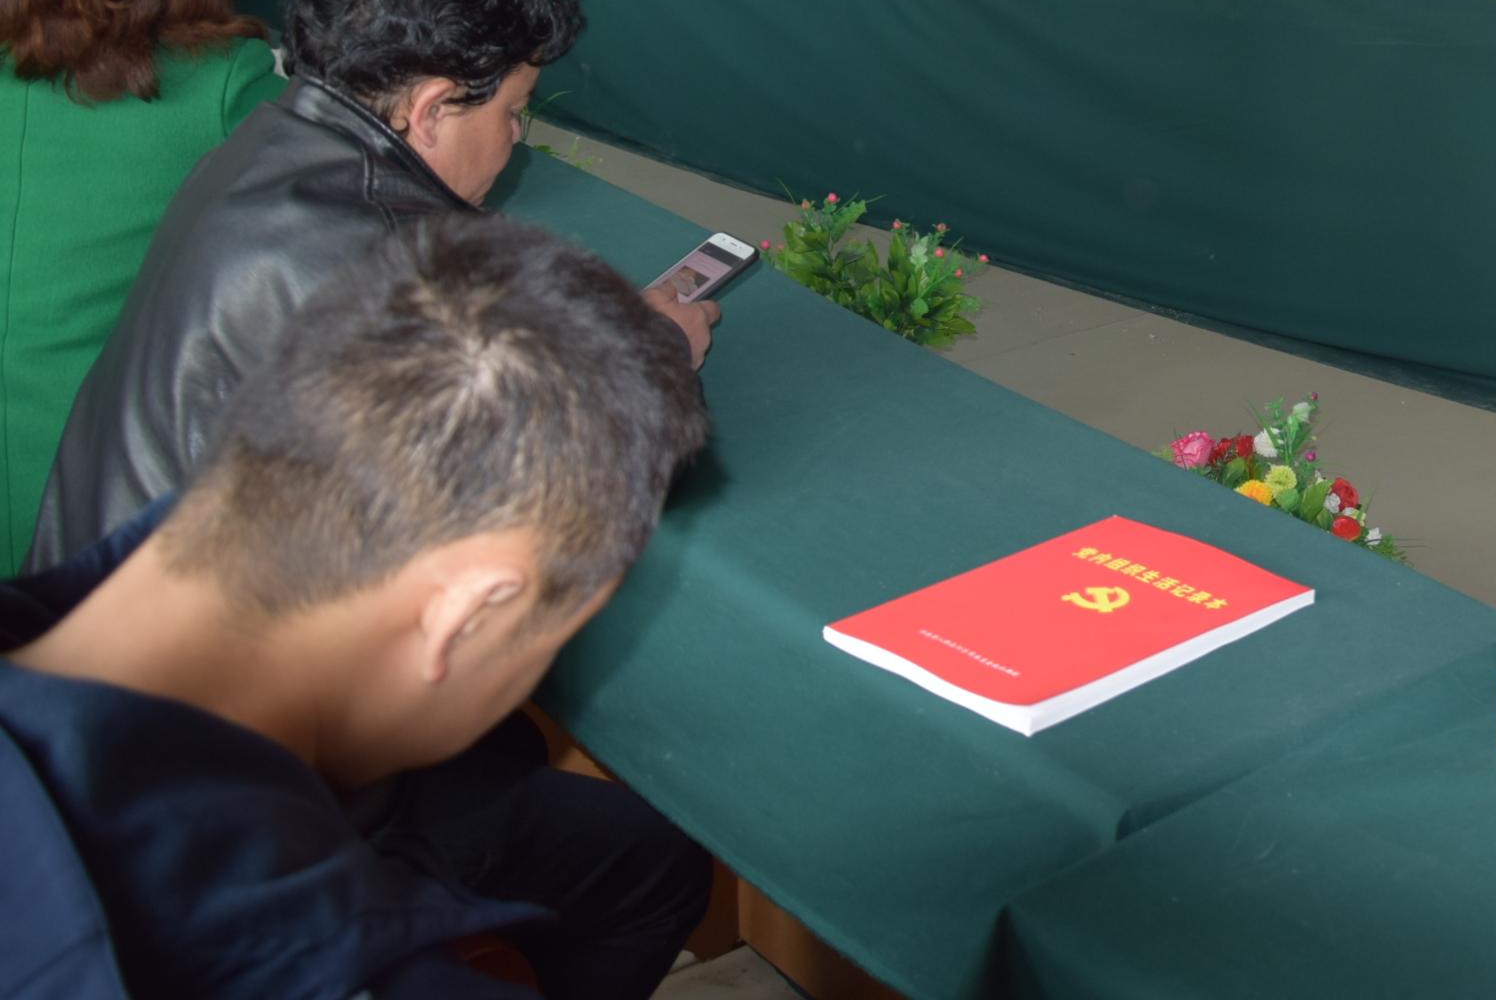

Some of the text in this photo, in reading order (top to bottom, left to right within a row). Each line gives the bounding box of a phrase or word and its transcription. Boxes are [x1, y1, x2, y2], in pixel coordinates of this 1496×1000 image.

[1072, 546, 1228, 610] 党内组织生活记录本
